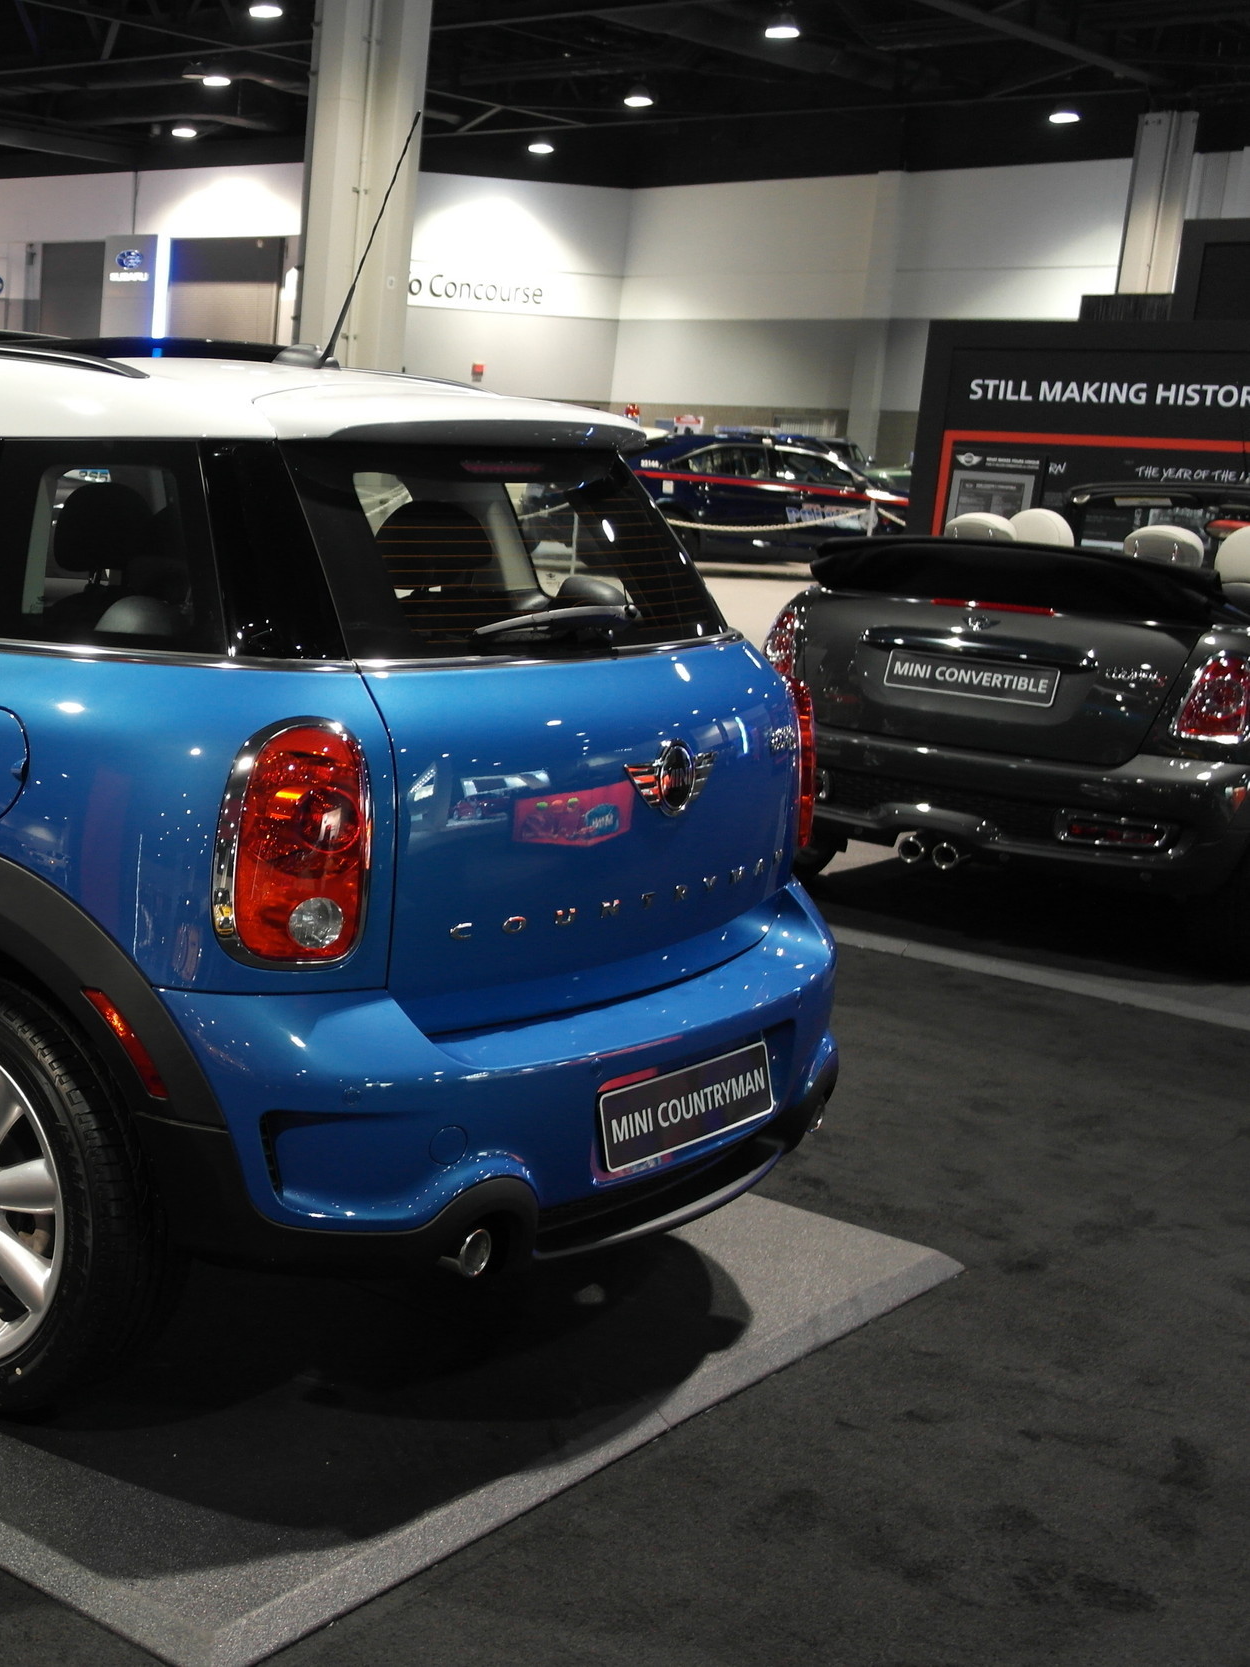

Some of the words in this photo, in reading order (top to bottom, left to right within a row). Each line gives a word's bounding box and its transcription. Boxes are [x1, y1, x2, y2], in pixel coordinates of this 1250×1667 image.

[109, 272, 149, 282] SUBARU
[429, 274, 543, 305] Concourse
[969, 379, 1033, 401] STILL
[1038, 380, 1148, 405] MAKING
[1134, 465, 1159, 479] THE
[1160, 467, 1193, 482] YEAR
[1193, 469, 1208, 480] OF
[1210, 468, 1237, 483] THE
[893, 661, 931, 679] MINI
[934, 666, 1049, 694] CONVERTIBLE
[663, 766, 692, 790] MINI
[449, 848, 784, 941] COUNTRYMAN
[611, 1107, 654, 1144] MINI
[657, 1066, 766, 1128] COUNTRYMAN
